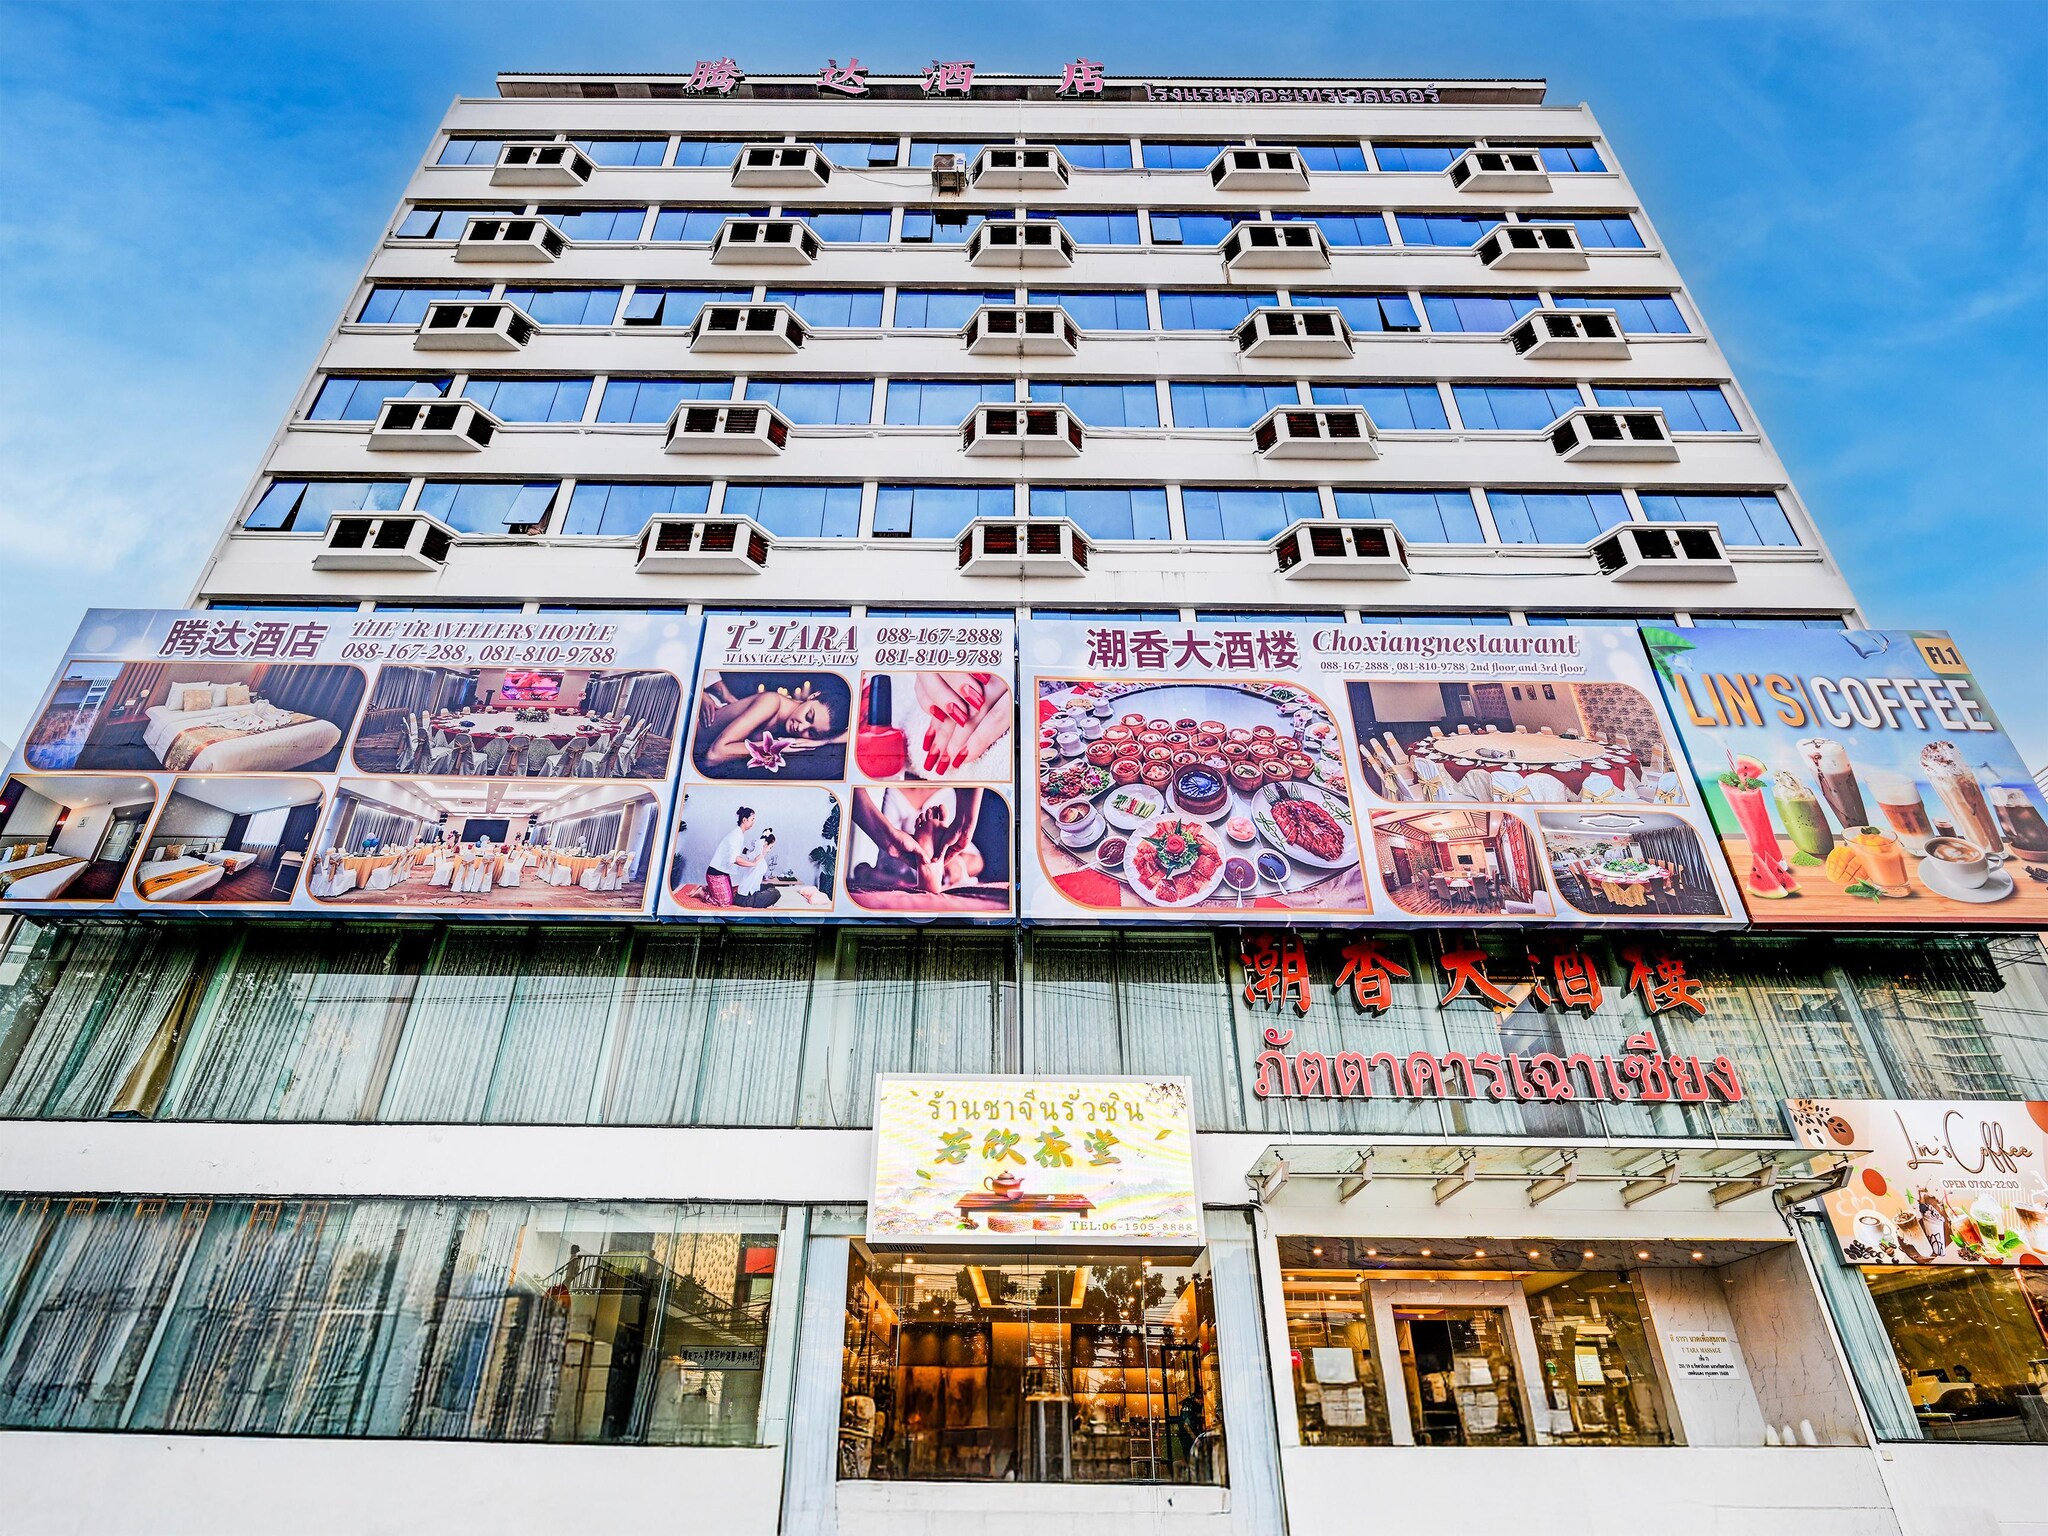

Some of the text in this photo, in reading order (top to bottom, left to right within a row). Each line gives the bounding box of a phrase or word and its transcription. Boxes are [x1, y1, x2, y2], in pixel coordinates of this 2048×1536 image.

[682, 56, 1105, 97] 腾达酒店
[158, 619, 329, 658] 腾达酒店
[351, 618, 616, 642] THE TRAVELLERS HOTLE
[725, 619, 858, 651] T-TARA
[876, 627, 1001, 644] 088-167-2888
[1312, 629, 1579, 657] Choxiangnestaurant
[479, 644, 616, 664] 081-810-9788
[875, 648, 1001, 665] 081-810-9788
[1086, 628, 1300, 669] 潮香大酒楼
[1396, 662, 1466, 672] 081-810-9788
[1470, 662, 1490, 672] 2nd
[1491, 662, 1516, 674] floor
[1518, 663, 1538, 673] and
[1540, 663, 1558, 673] 3rd
[1559, 663, 1585, 675] floor
[1810, 676, 1994, 731] COFFEE
[1254, 1027, 1743, 1102] ภัตตาคารเฉาเซียง
[1942, 1180, 2019, 1189] OPEN 07:00-22:00
